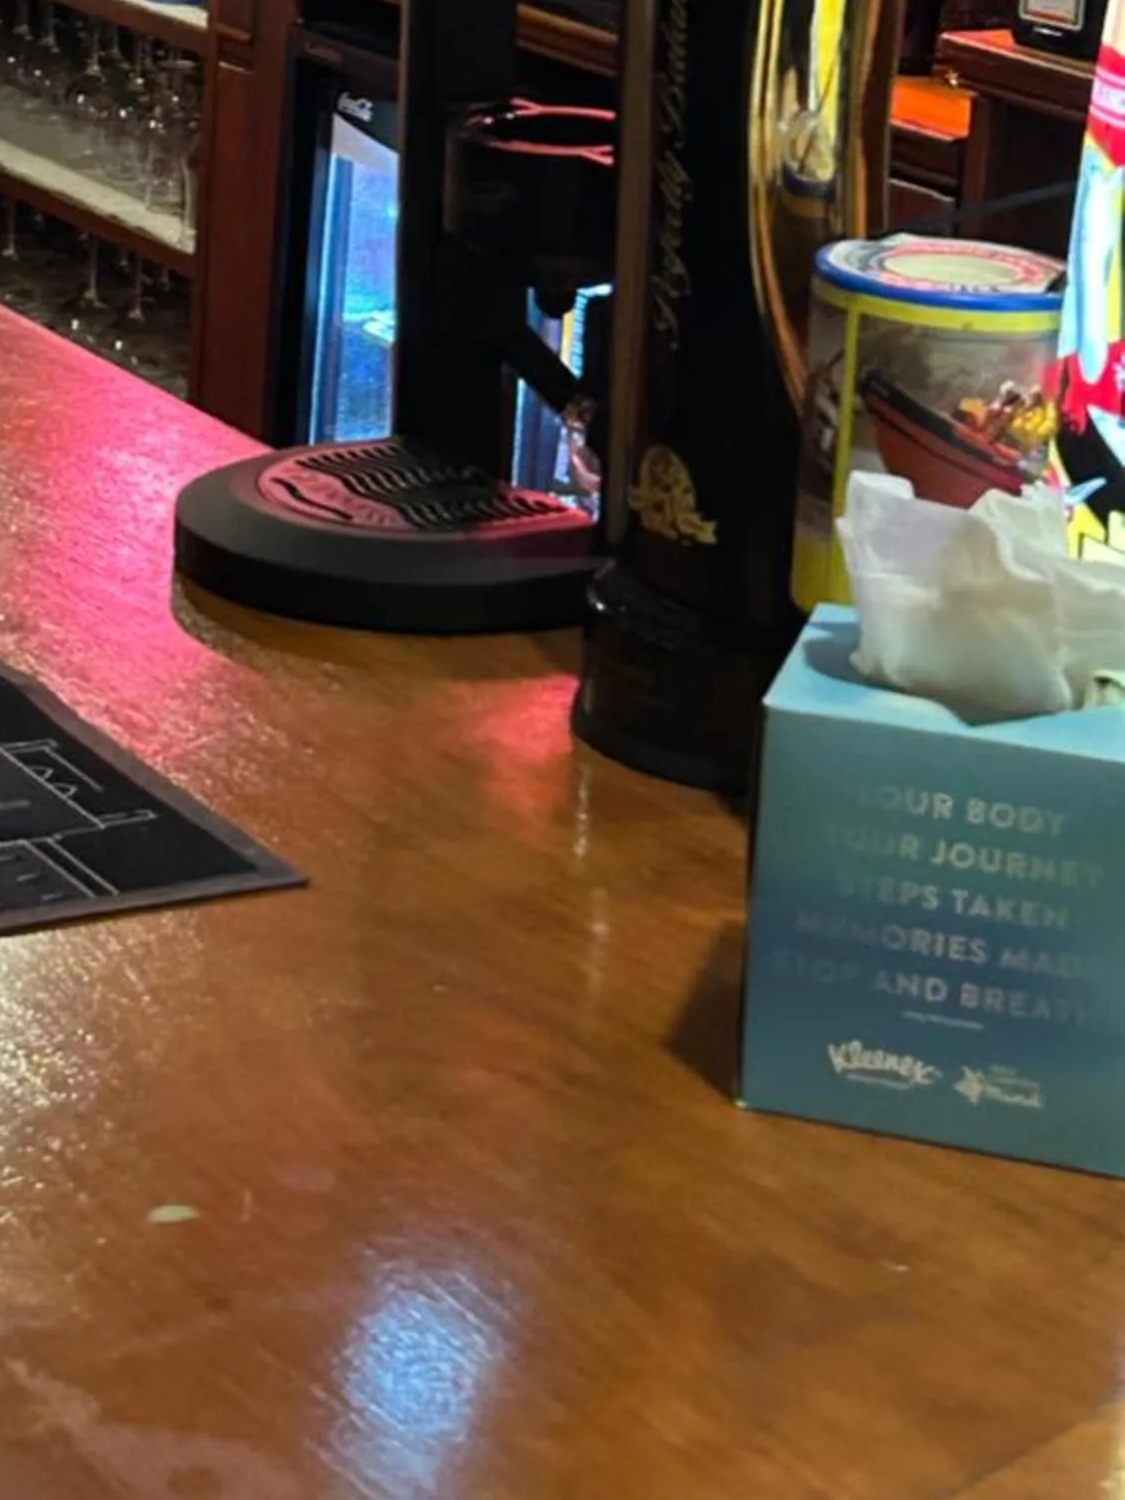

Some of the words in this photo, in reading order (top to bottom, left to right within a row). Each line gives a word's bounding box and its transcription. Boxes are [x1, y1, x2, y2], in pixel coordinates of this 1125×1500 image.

[859, 785, 954, 822] OUR
[965, 798, 1067, 837] BODY
[951, 889, 1071, 931] TAKEN
[999, 946, 1089, 982] MAD
[873, 970, 946, 1003] AND
[959, 981, 1097, 1026] BREATH
